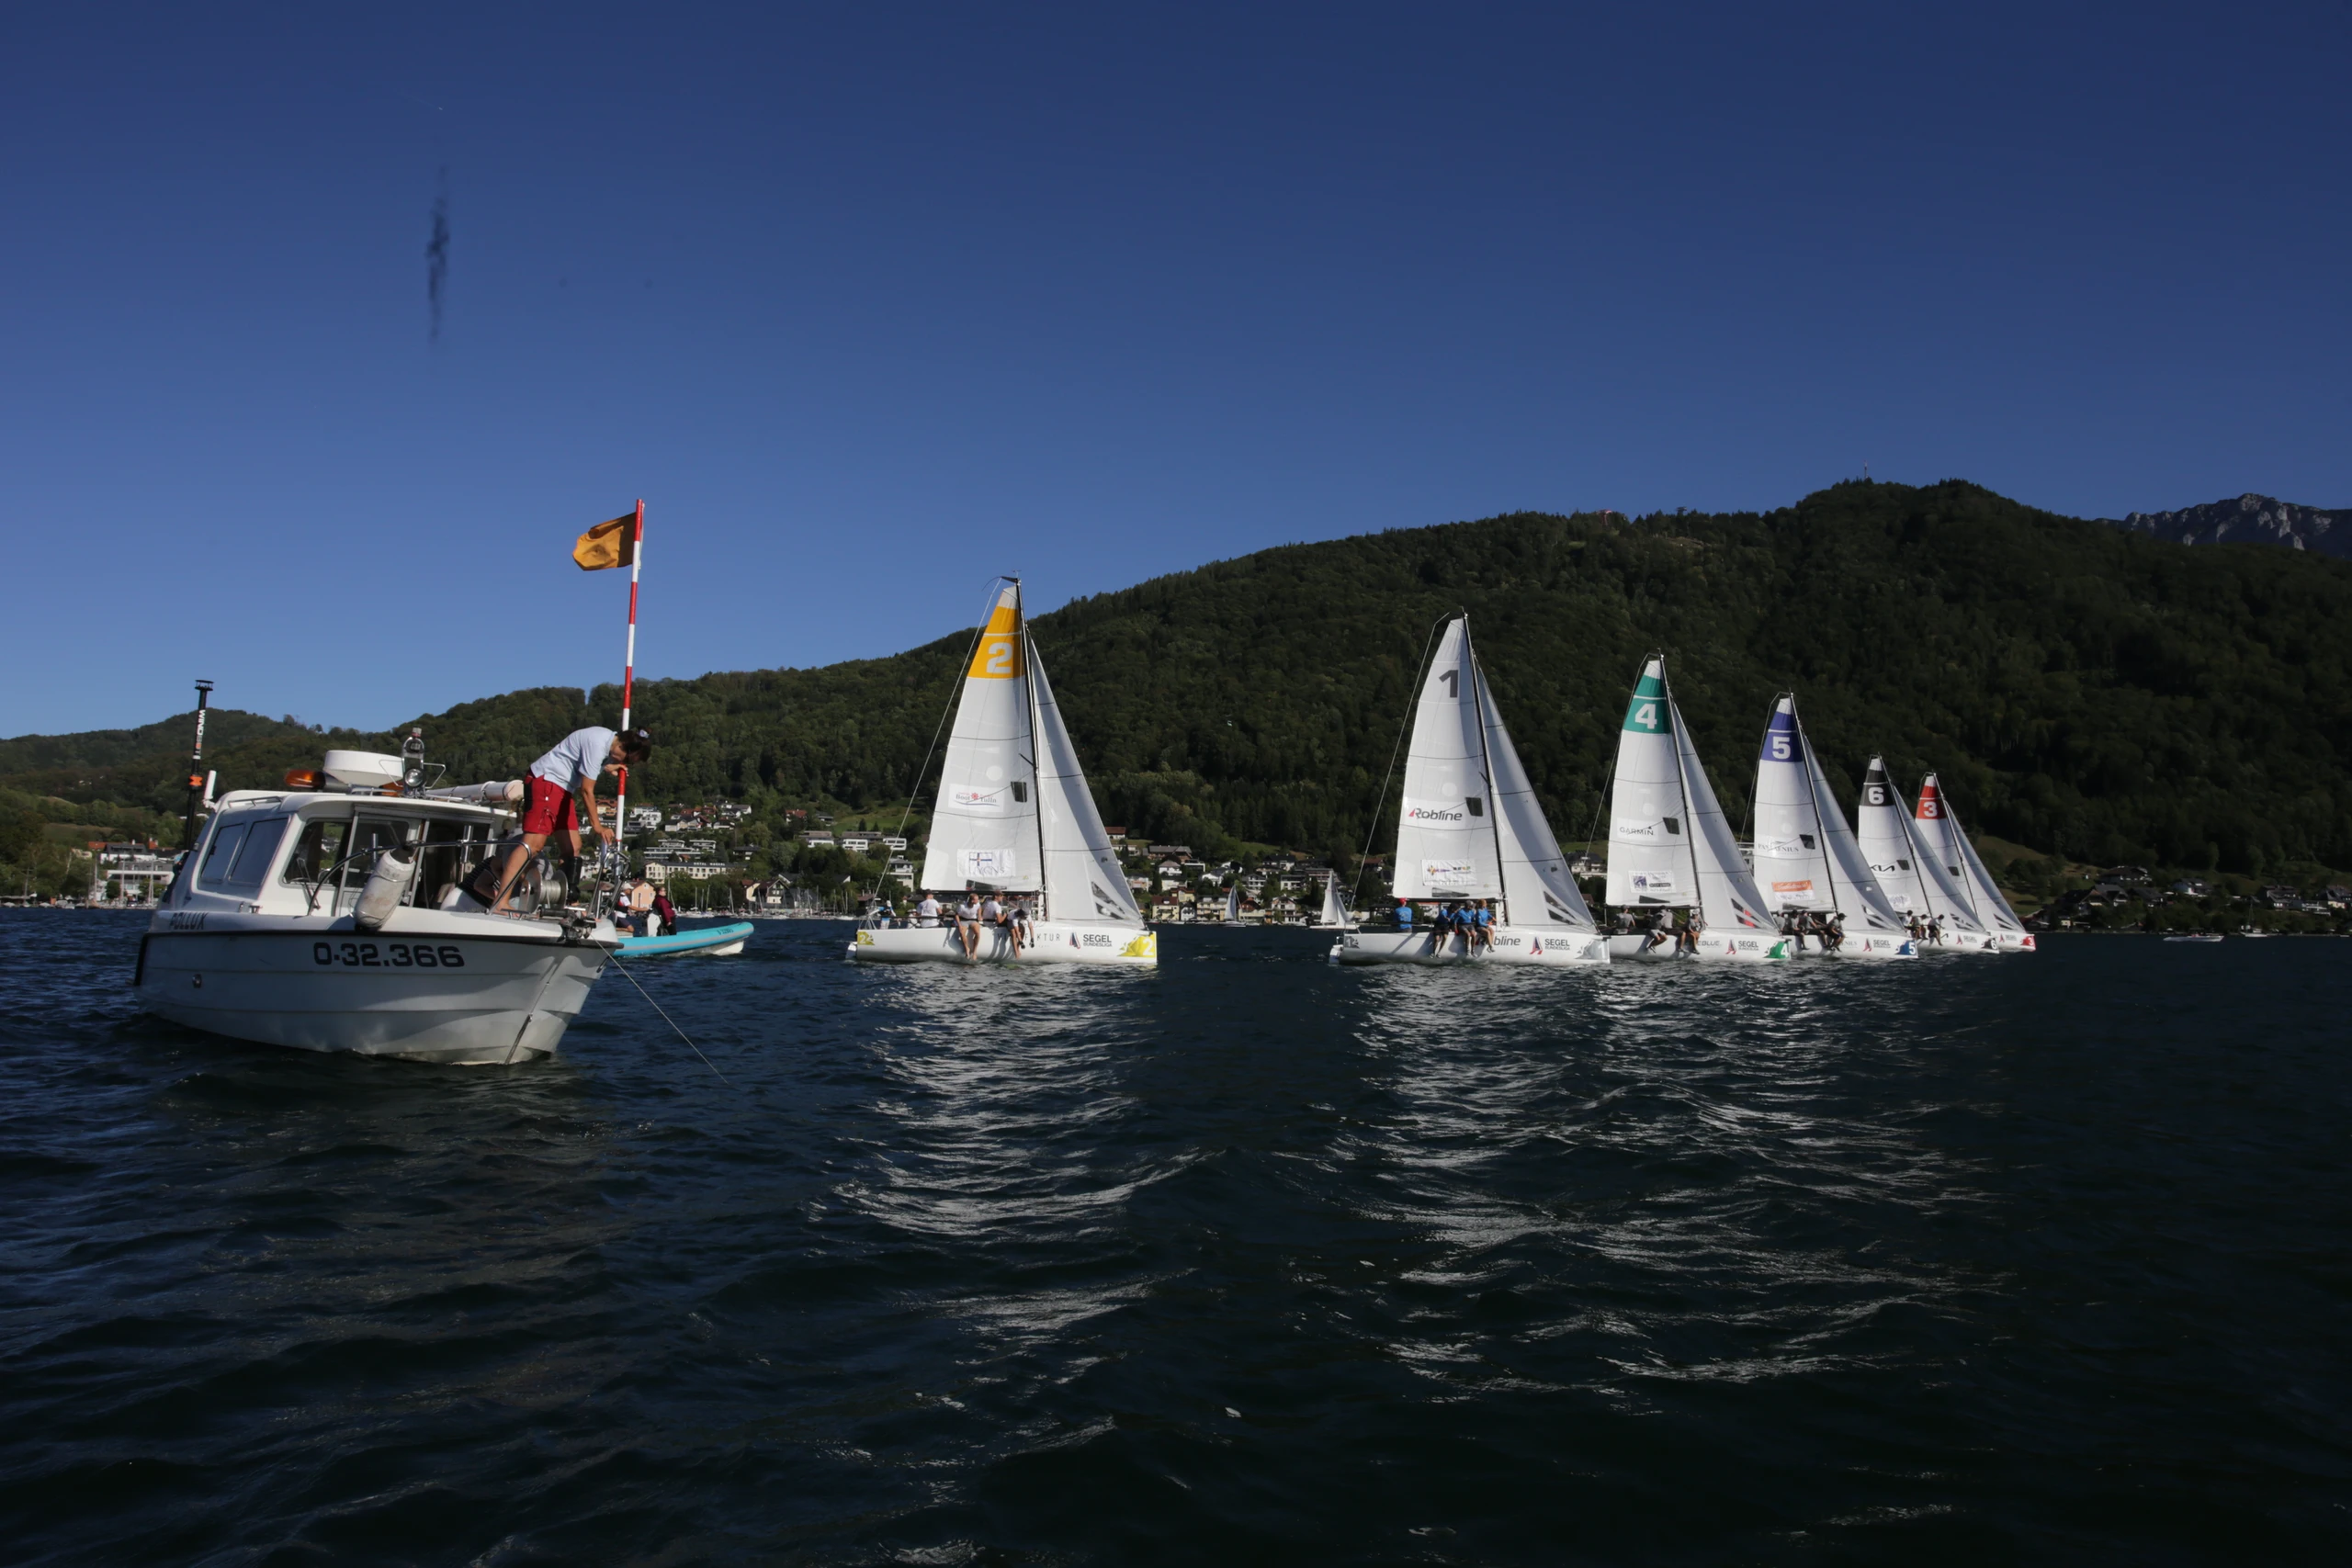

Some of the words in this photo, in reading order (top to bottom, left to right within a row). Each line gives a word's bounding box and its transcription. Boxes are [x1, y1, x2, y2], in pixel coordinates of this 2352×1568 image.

[986, 642, 1013, 674] 2
[1439, 670, 1459, 698] 1
[1634, 703, 1657, 729] 4
[1772, 736, 1791, 760] 5
[1868, 786, 1884, 805] 6
[1408, 807, 1463, 821] Robline
[1923, 801, 1939, 818] 3
[1619, 826, 1655, 836] GARMIN
[169, 912, 209, 931] POLLUX
[860, 934, 866, 944] 2
[1082, 933, 1112, 943] SEGEL
[1544, 938, 1570, 947] SEGEL
[1990, 939, 1997, 950] 6
[2028, 937, 2034, 947] 3
[1142, 938, 1154, 956] 2
[1598, 941, 1606, 959] 1
[1780, 942, 1790, 959] 4
[1908, 942, 1916, 955] 5
